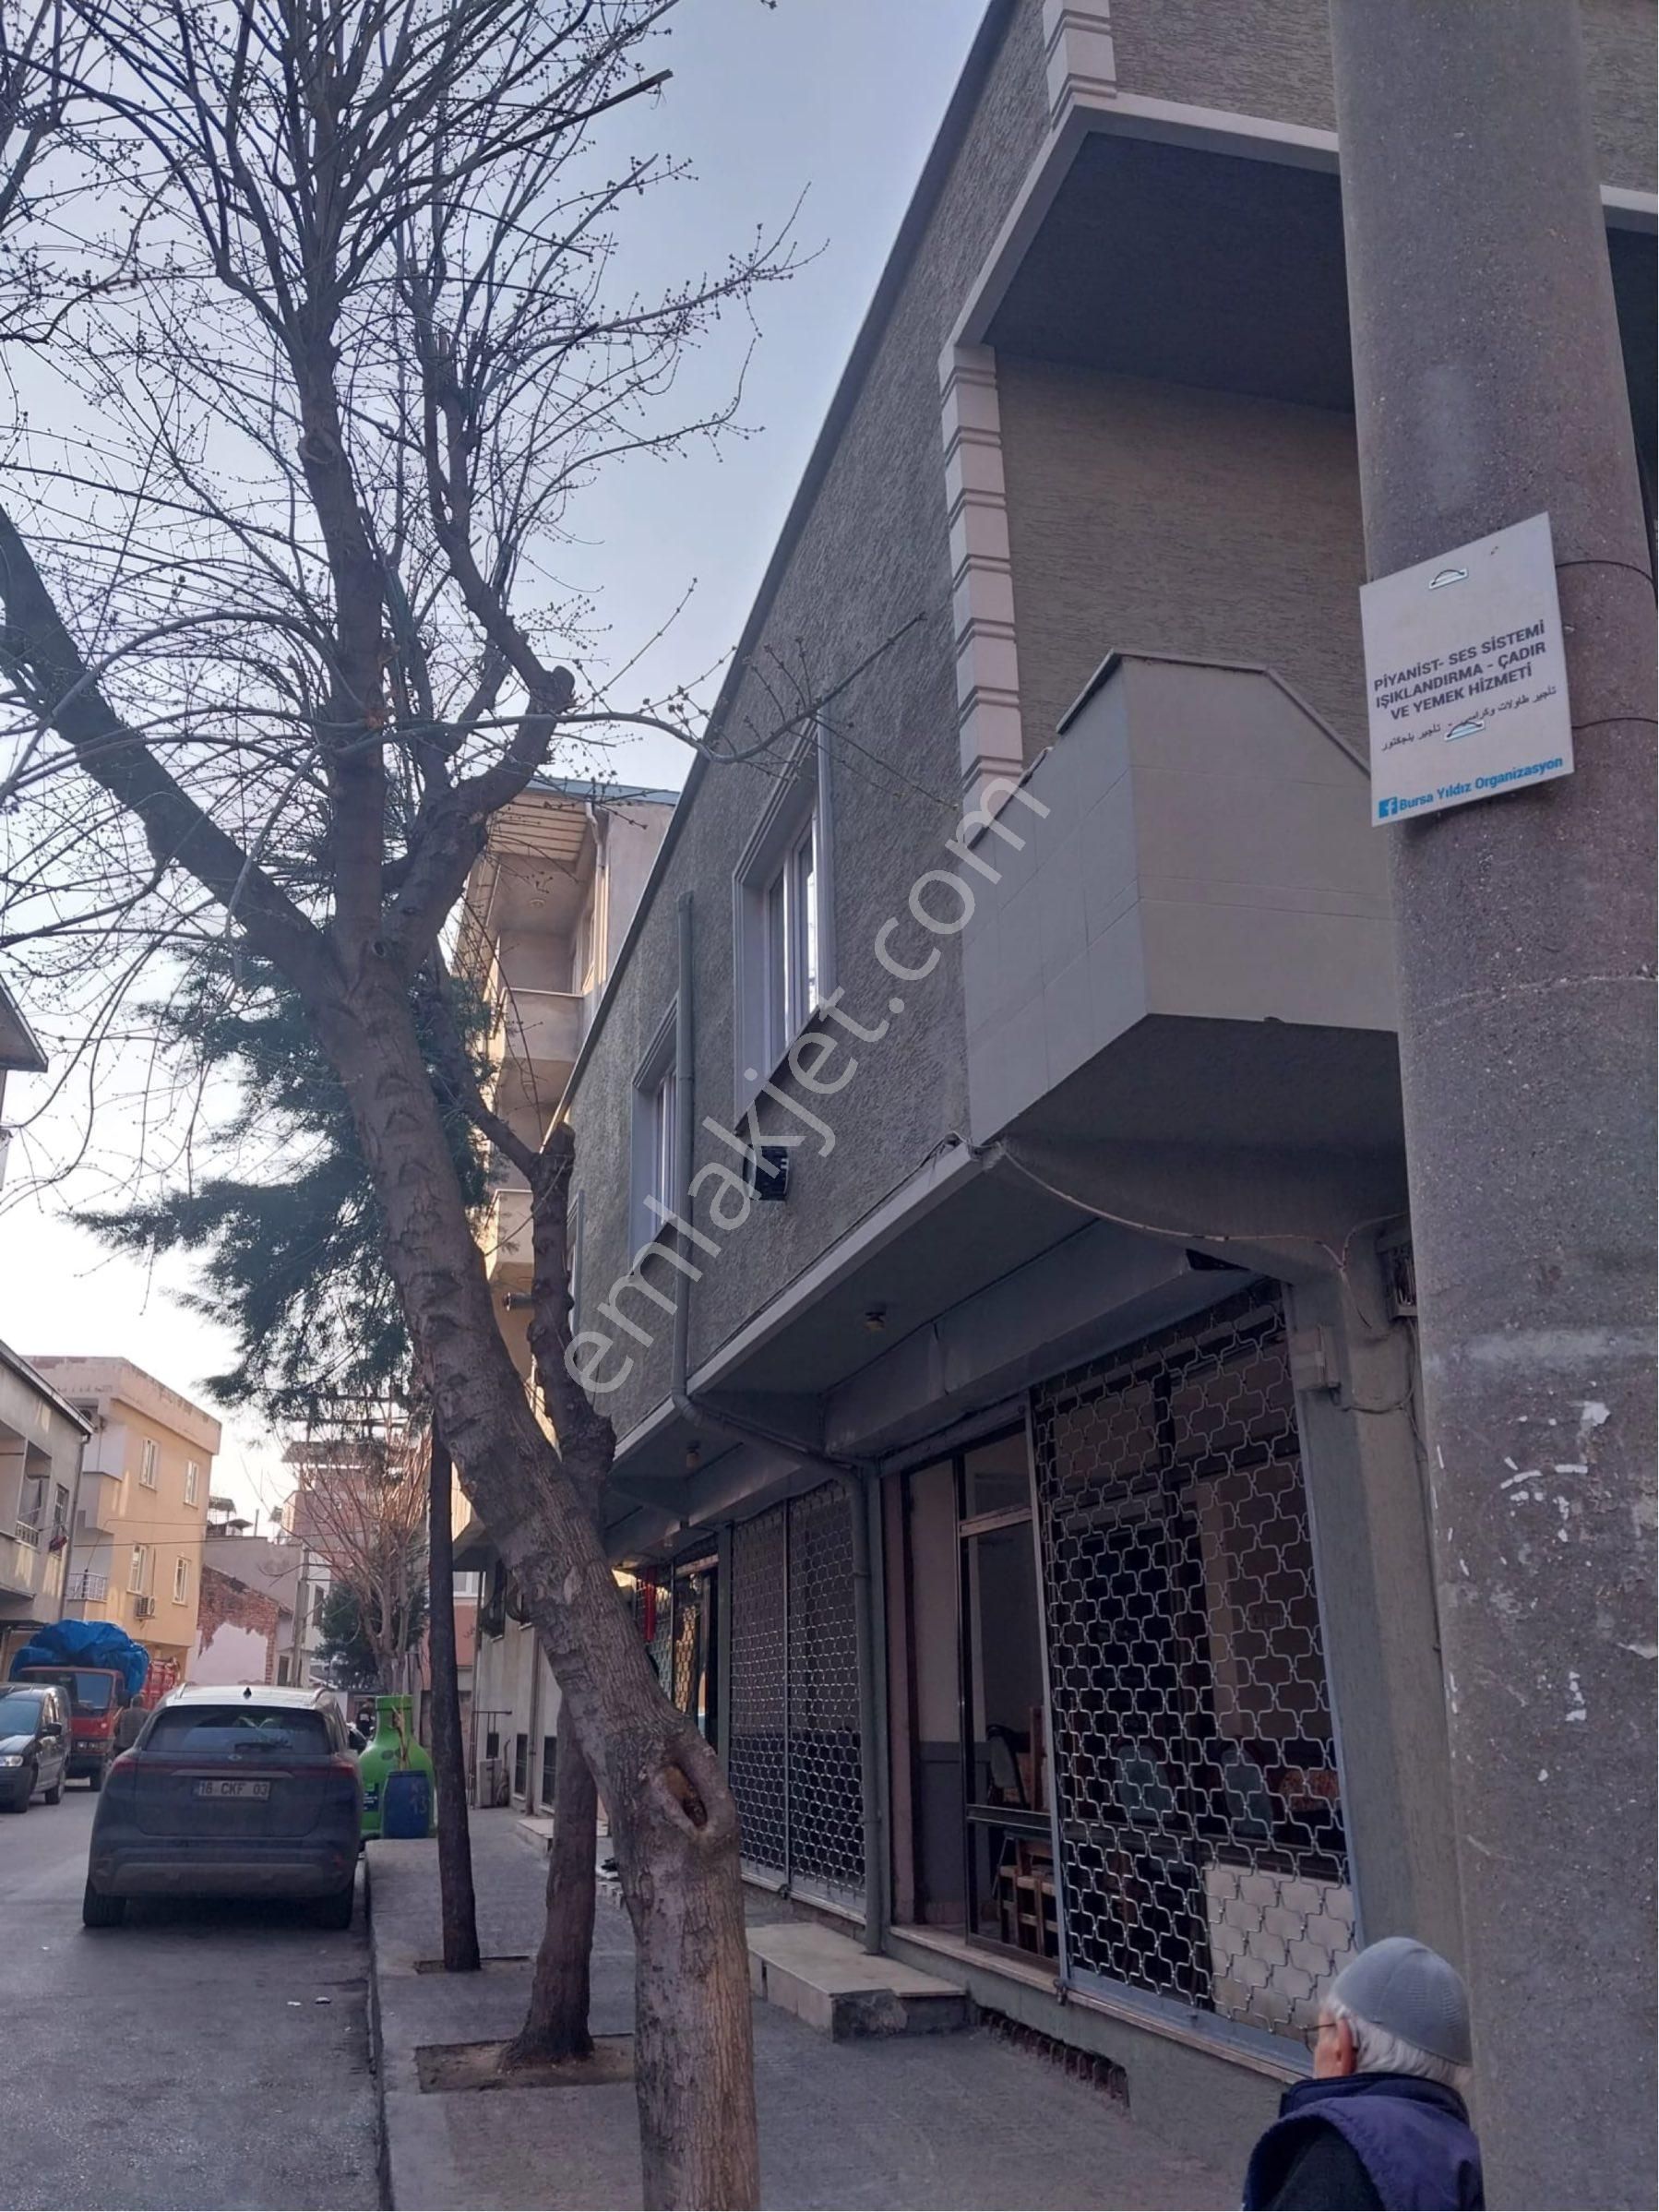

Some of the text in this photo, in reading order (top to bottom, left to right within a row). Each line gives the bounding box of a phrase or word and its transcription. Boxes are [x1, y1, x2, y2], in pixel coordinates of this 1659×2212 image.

[1449, 646, 1477, 665] SES
[1481, 619, 1546, 654] SİSTEMİ
[1376, 664, 1483, 709] IŞIKLANDIRMA
[1498, 641, 1546, 669] ÇADIR
[1390, 662, 1532, 720] VE YEMEK HİZMETİ
[1399, 793, 1434, 810] Bursa
[1437, 782, 1472, 800] Yıldız
[1475, 758, 1563, 789] Organizasyon
